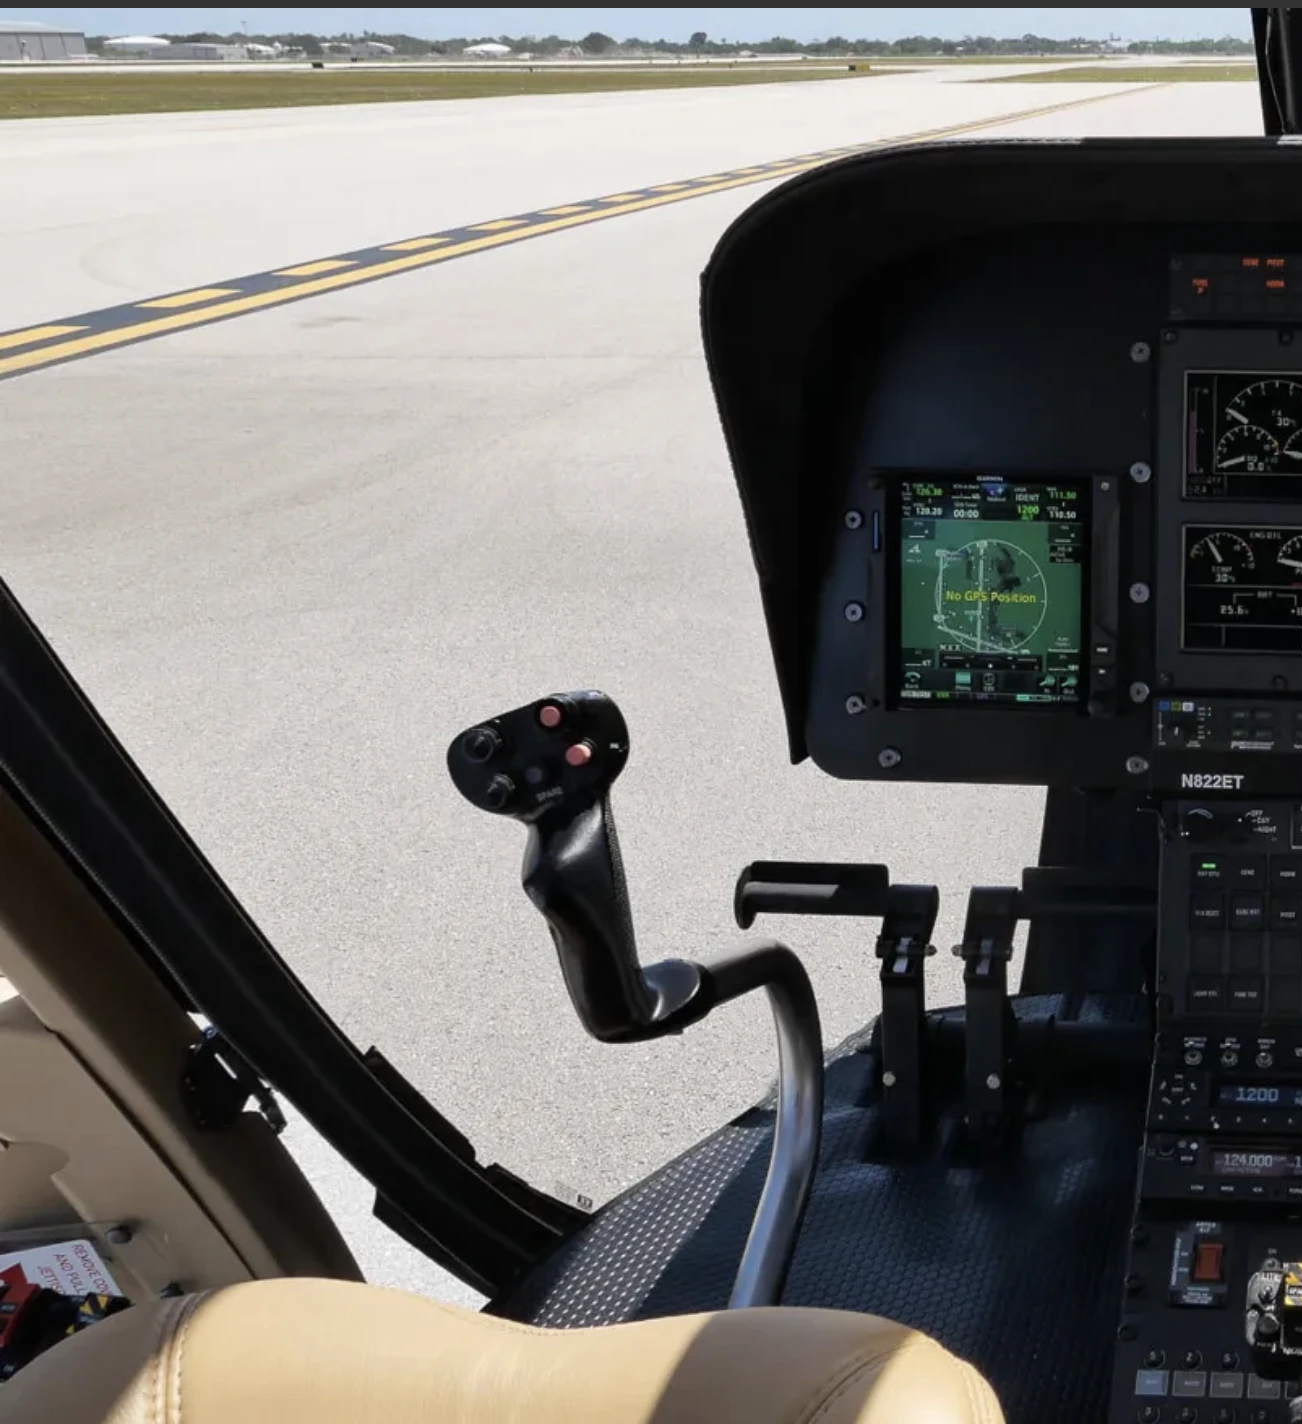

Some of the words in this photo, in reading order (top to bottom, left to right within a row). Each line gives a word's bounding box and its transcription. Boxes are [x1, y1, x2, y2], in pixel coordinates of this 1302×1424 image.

[953, 509, 980, 519] 00:00
[1017, 504, 1040, 515] 1200
[945, 590, 962, 602] No
[964, 591, 988, 602] GPS
[991, 591, 1037, 604] Position
[1181, 774, 1245, 790] N822ET
[1235, 1086, 1279, 1103] 1200
[1223, 1153, 1273, 1168] 124.000
[72, 1244, 102, 1279] REMOVE
[52, 1254, 74, 1272] AND
[66, 1272, 87, 1294] PULL
